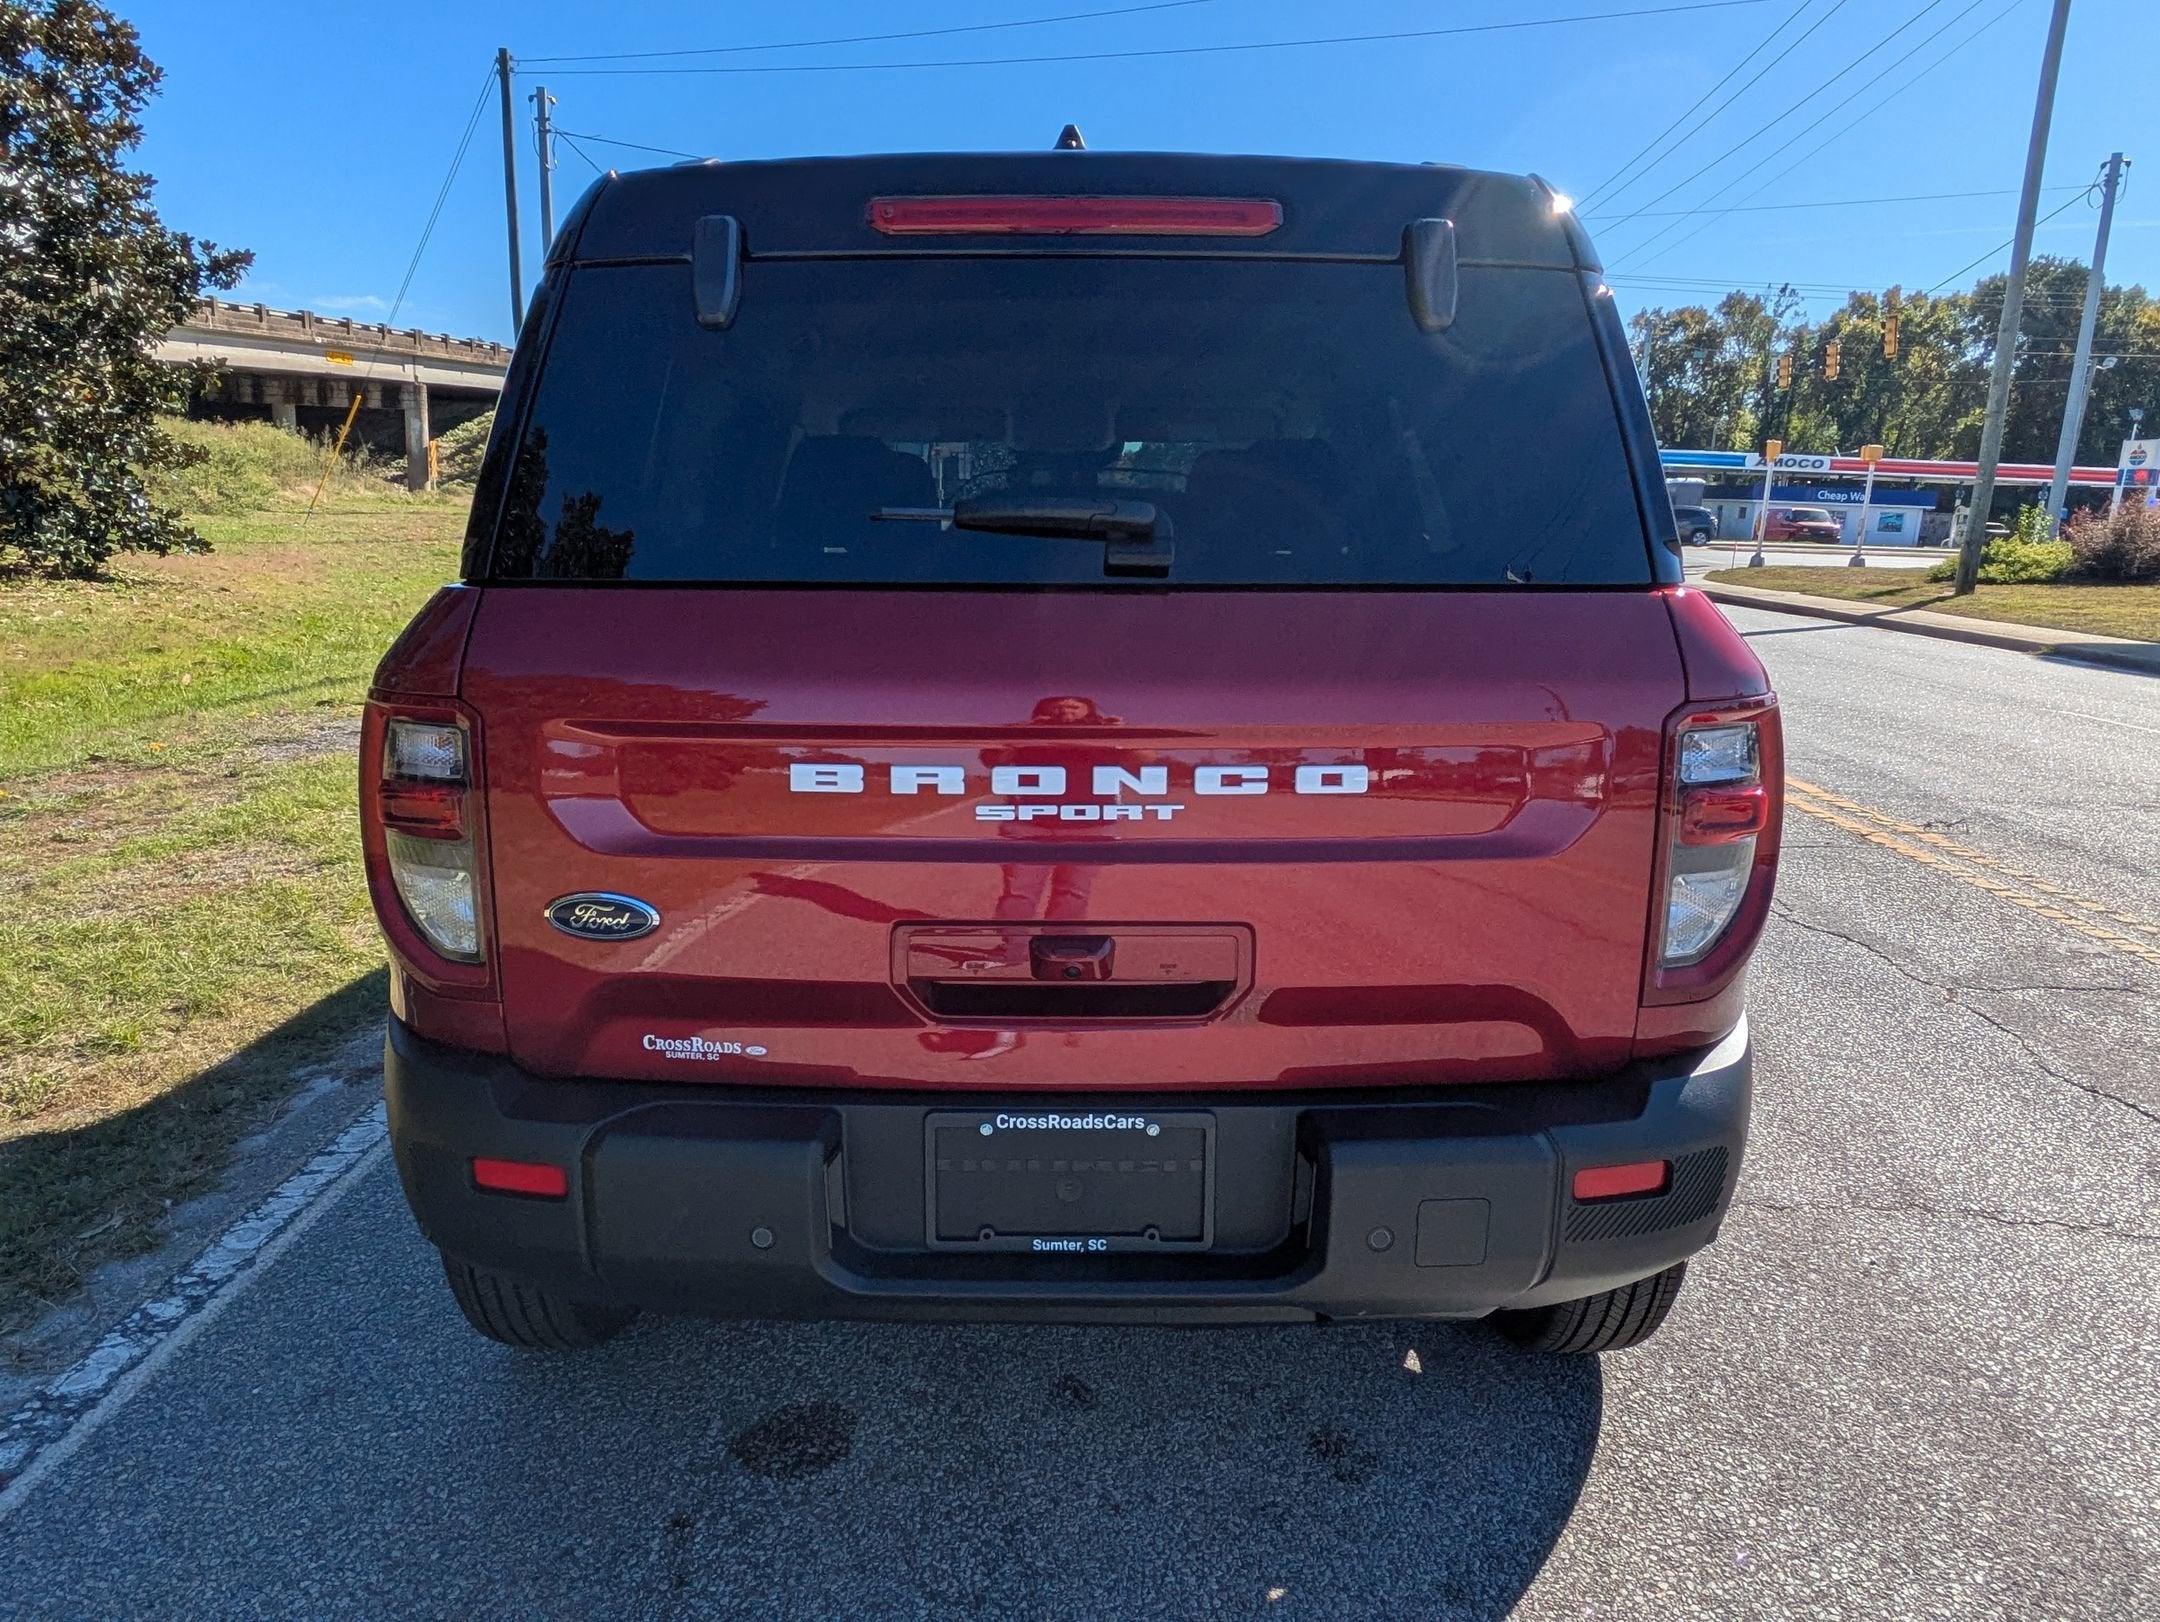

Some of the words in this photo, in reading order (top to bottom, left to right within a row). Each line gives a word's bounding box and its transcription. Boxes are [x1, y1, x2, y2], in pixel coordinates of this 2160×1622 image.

[1818, 490, 1848, 502] Cheap
[1850, 491, 1870, 502] Wa
[790, 764, 1369, 796] BRONCO
[975, 804, 1184, 821] SPORT
[570, 903, 630, 930] Ford
[996, 1114, 1145, 1130] CrossRoadsCars
[1032, 1239, 1084, 1252] Sumter,
[1088, 1239, 1107, 1251] SC
